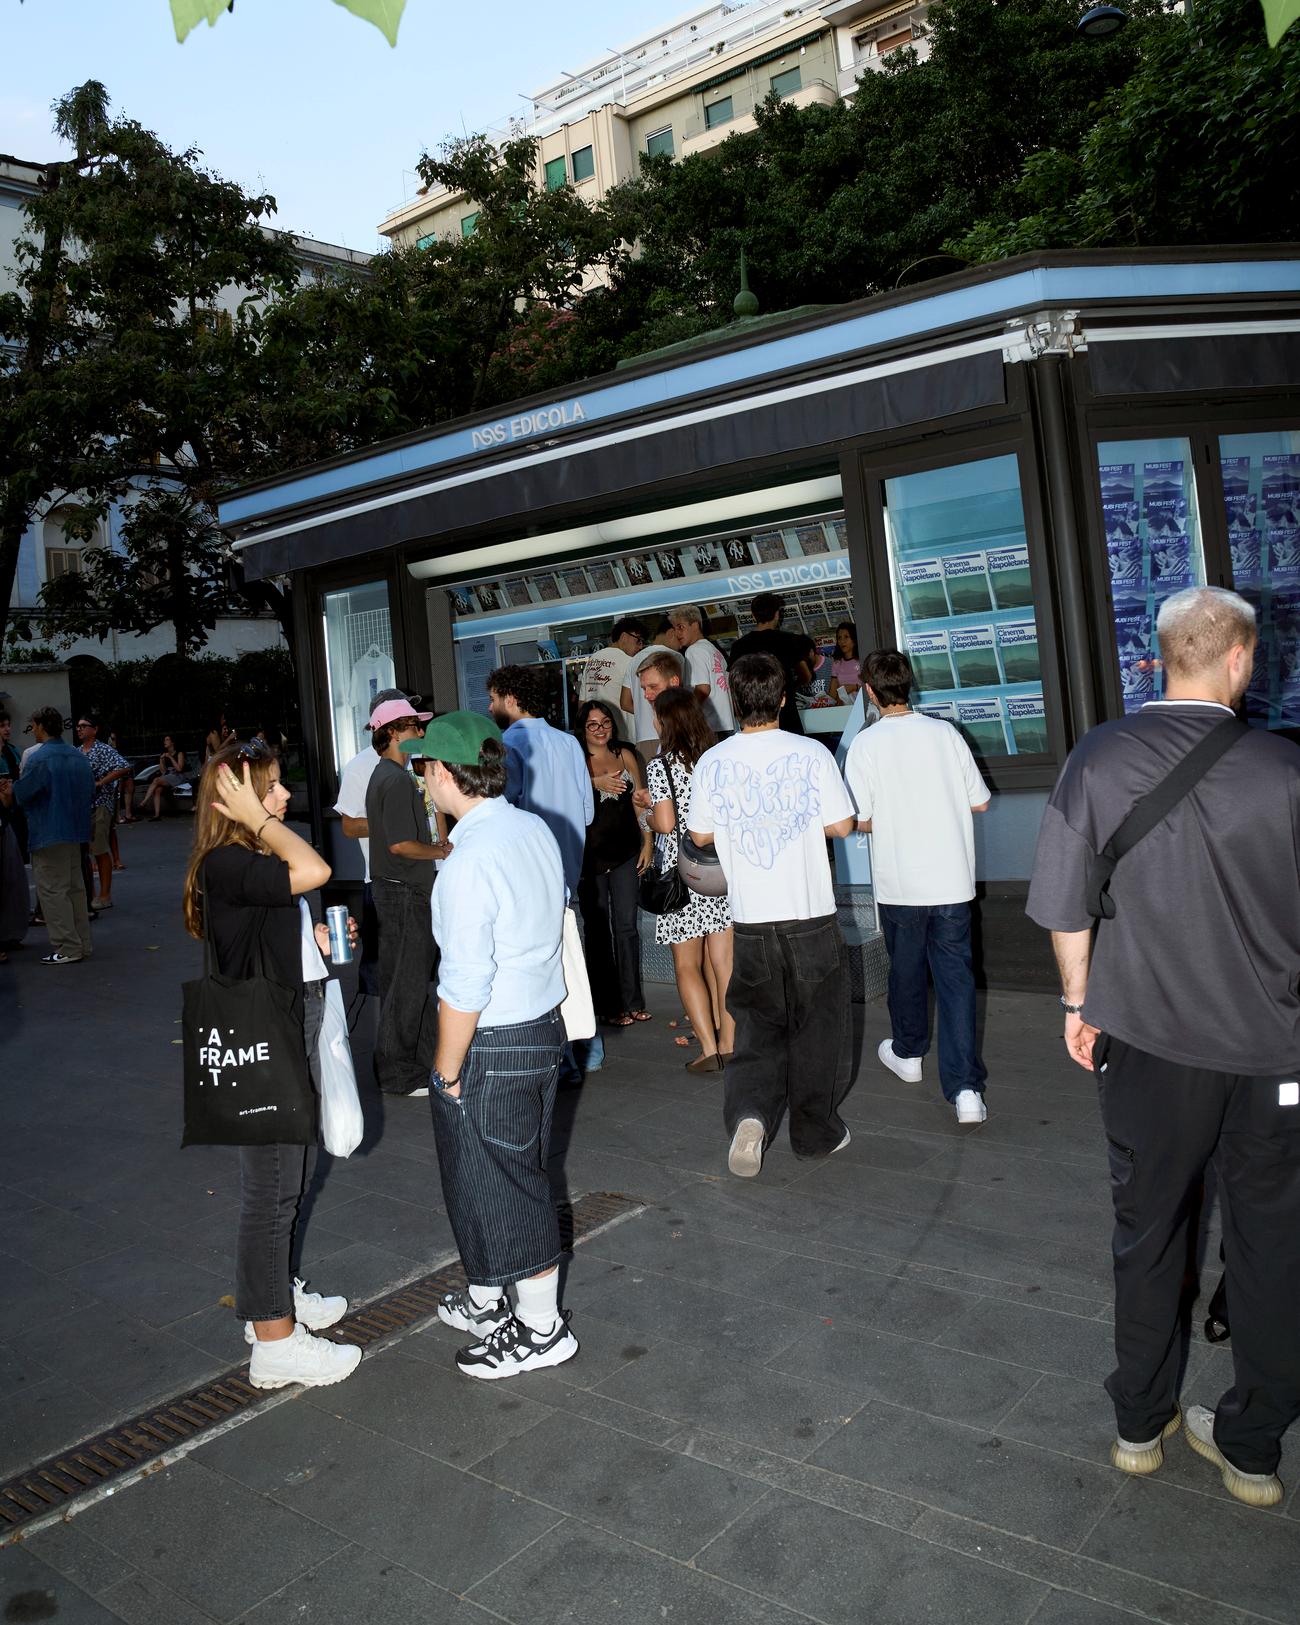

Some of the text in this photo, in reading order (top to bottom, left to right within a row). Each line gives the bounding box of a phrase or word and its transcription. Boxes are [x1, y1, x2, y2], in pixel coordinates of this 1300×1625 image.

[511, 401, 584, 437] EDICOLA
[987, 553, 1016, 563] Cinema
[943, 560, 970, 569] Cinema
[769, 559, 850, 586] EDICOLA
[902, 567, 927, 576] Cinema
[945, 565, 985, 576] Napoletano
[903, 572, 941, 583] Napoletano
[997, 628, 1025, 636] Cinema
[908, 639, 933, 647] Cinema
[951, 634, 978, 642] Cinema
[952, 638, 993, 649] Napoletano
[999, 633, 1037, 644] Napoletan
[959, 707, 986, 715] Cinema
[1007, 703, 1035, 711] Cinema
[960, 712, 1000, 721] Napoletano
[208, 1028, 222, 1046] A
[200, 1042, 270, 1067] FRAME
[209, 1068, 222, 1086] T
[239, 1104, 278, 1116] art-frame.org
